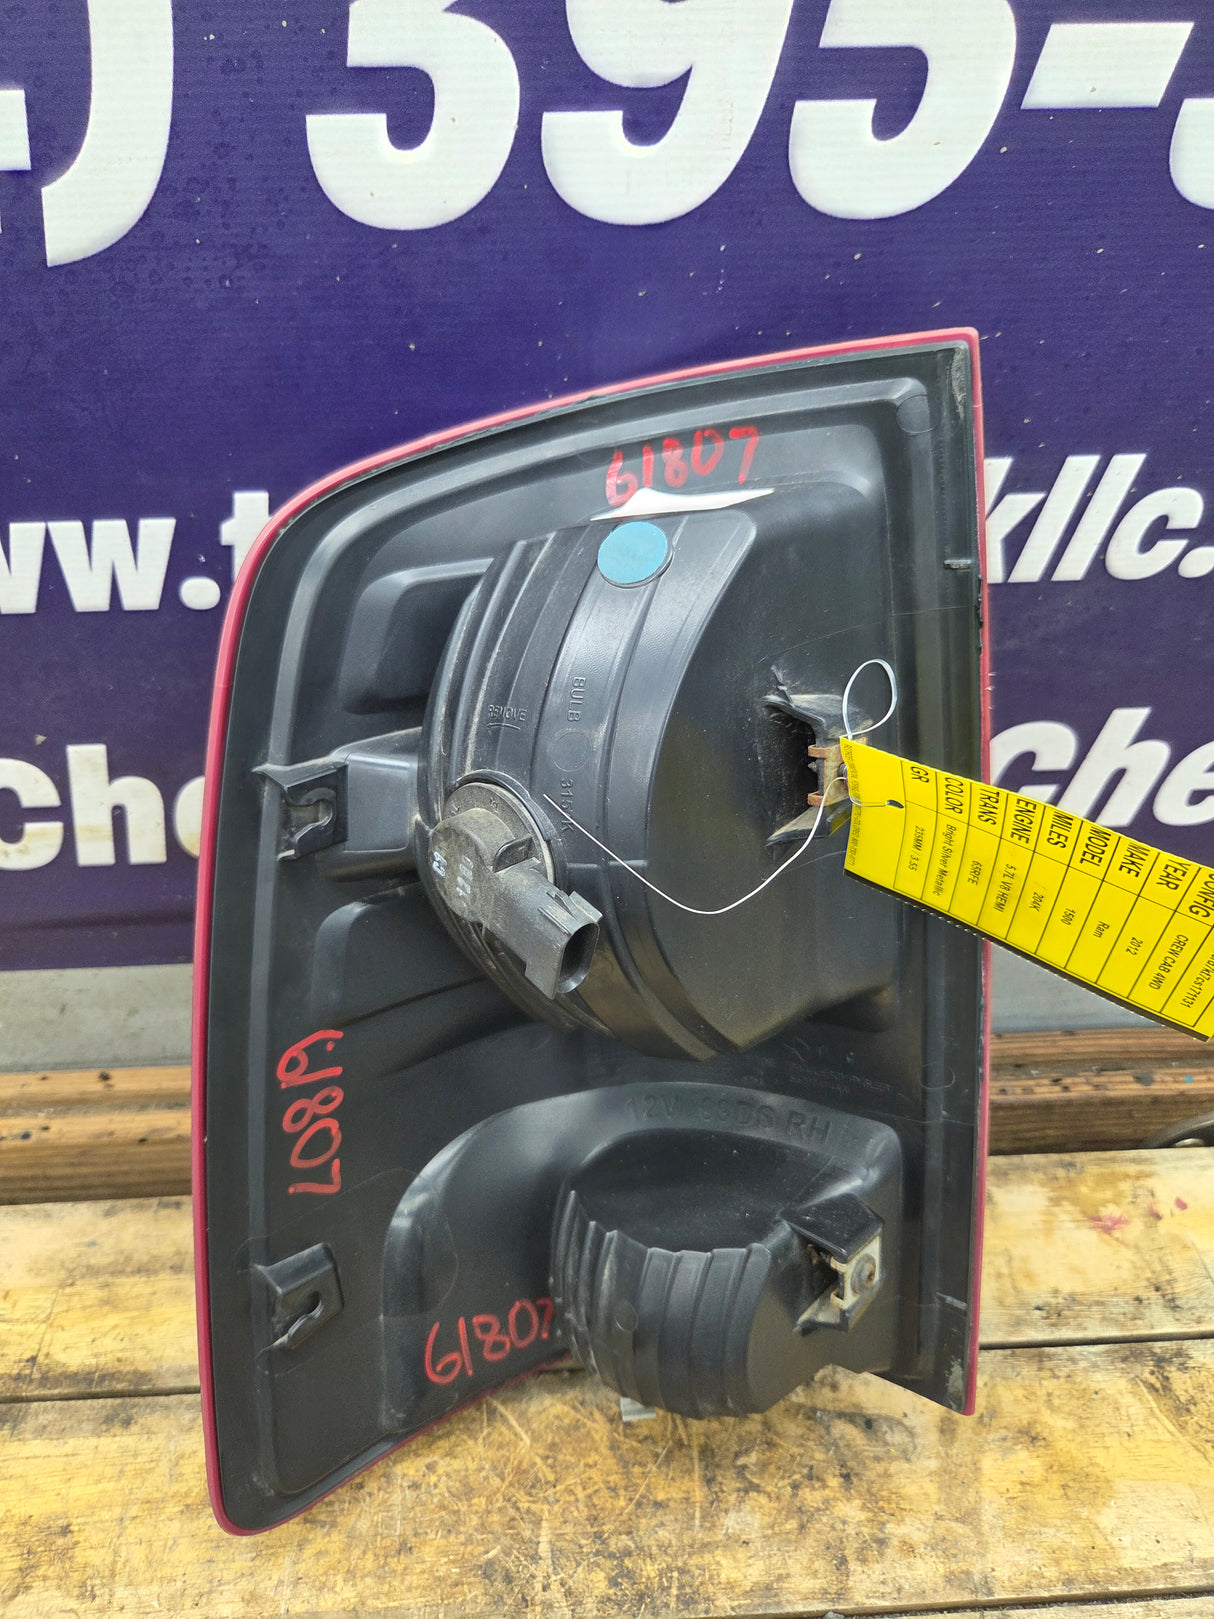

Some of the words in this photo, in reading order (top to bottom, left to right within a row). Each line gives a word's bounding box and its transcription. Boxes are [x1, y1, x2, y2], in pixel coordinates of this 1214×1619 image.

[606, 426, 759, 508] 61807
[567, 676, 587, 722] BULB
[910, 766, 930, 784] GR
[560, 778, 576, 833] 315K
[944, 777, 964, 815] COLOR
[977, 788, 1000, 826] TRANS
[1010, 798, 1037, 844] ENGINE
[1046, 810, 1074, 849] MILES
[942, 823, 957, 849] Bright
[1079, 826, 1112, 867] MODEL
[939, 847, 953, 868] Silver
[1118, 842, 1150, 878] MAKE
[1000, 880, 1013, 891] V8
[1156, 859, 1192, 891] YEAR
[993, 890, 1009, 913] HEMI
[1060, 908, 1076, 926] 1500
[1092, 920, 1110, 938] Ram
[1125, 936, 1144, 956] 2012
[1167, 933, 1189, 958] CREW
[1158, 955, 1176, 974] CAB
[1149, 972, 1167, 990] 4WD
[784, 1110, 834, 1145] RH
